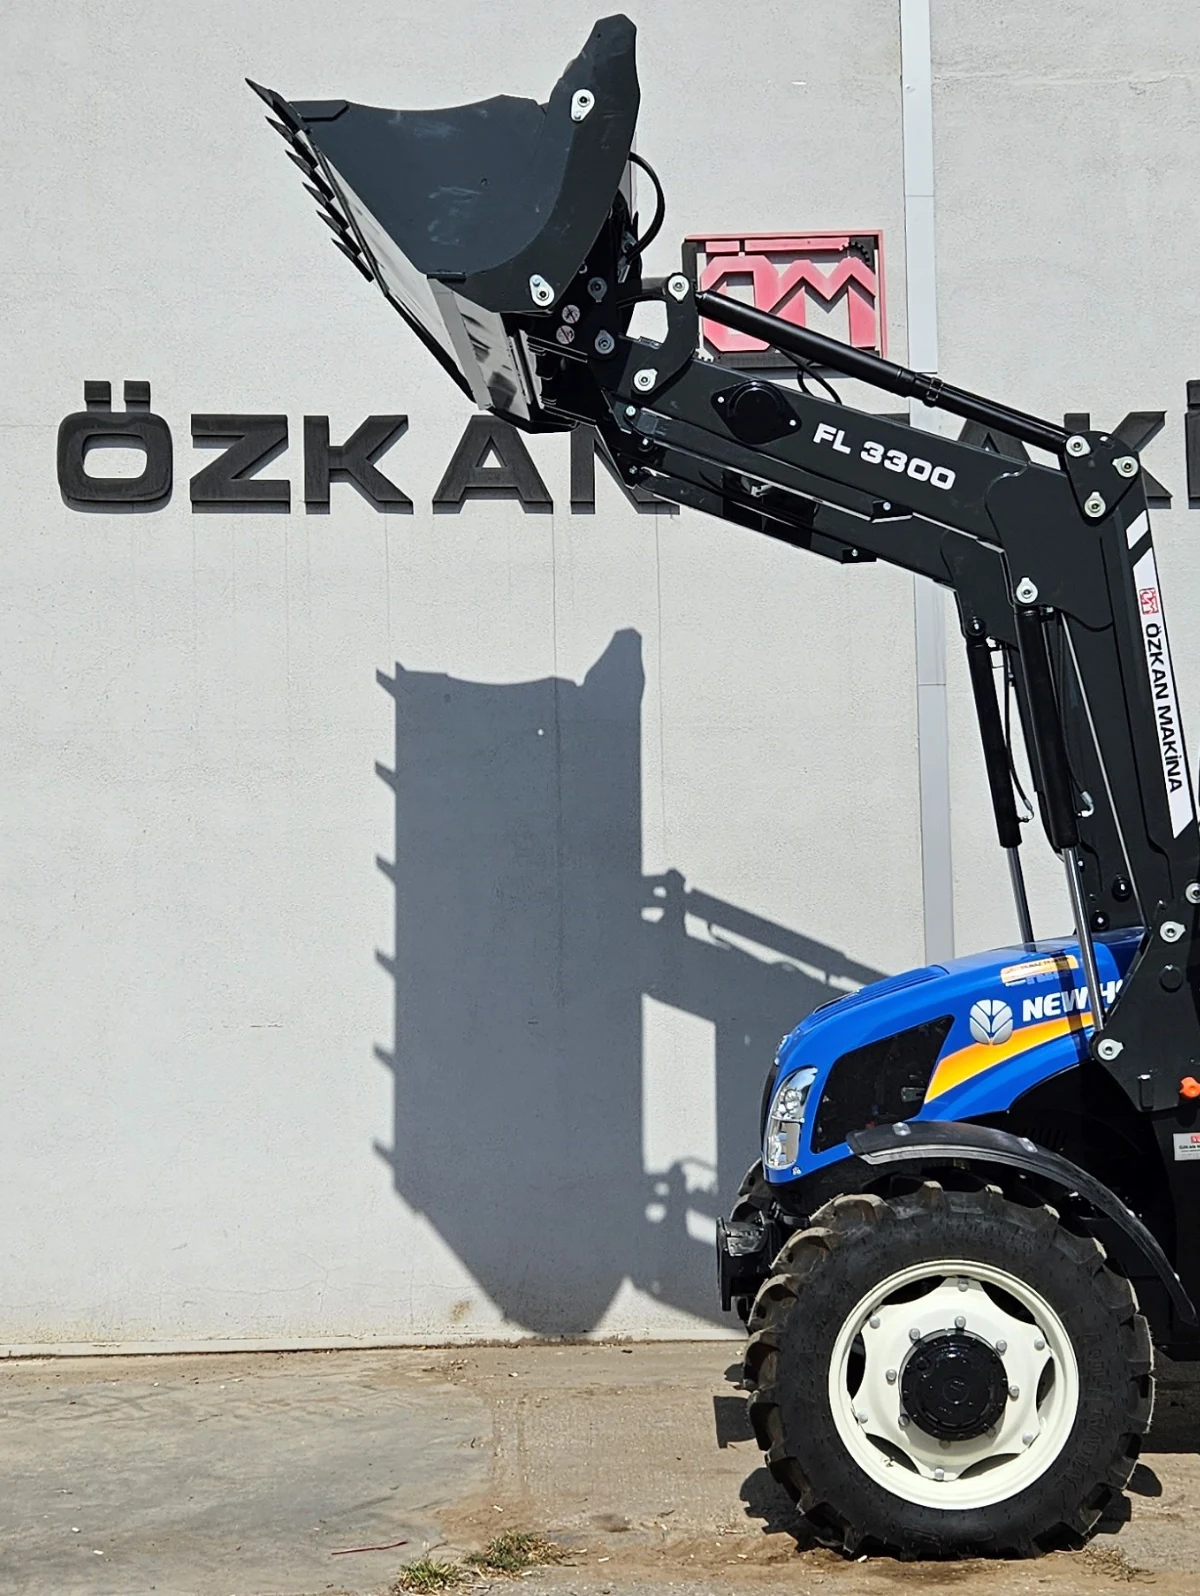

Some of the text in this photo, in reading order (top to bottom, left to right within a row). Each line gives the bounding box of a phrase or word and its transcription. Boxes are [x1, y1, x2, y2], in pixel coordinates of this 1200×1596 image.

[812, 422, 957, 491] FL 3300
[1145, 622, 1169, 700] ÖZKAN
[1157, 705, 1183, 793] MAKİNA
[1022, 986, 1089, 1022] NEW
